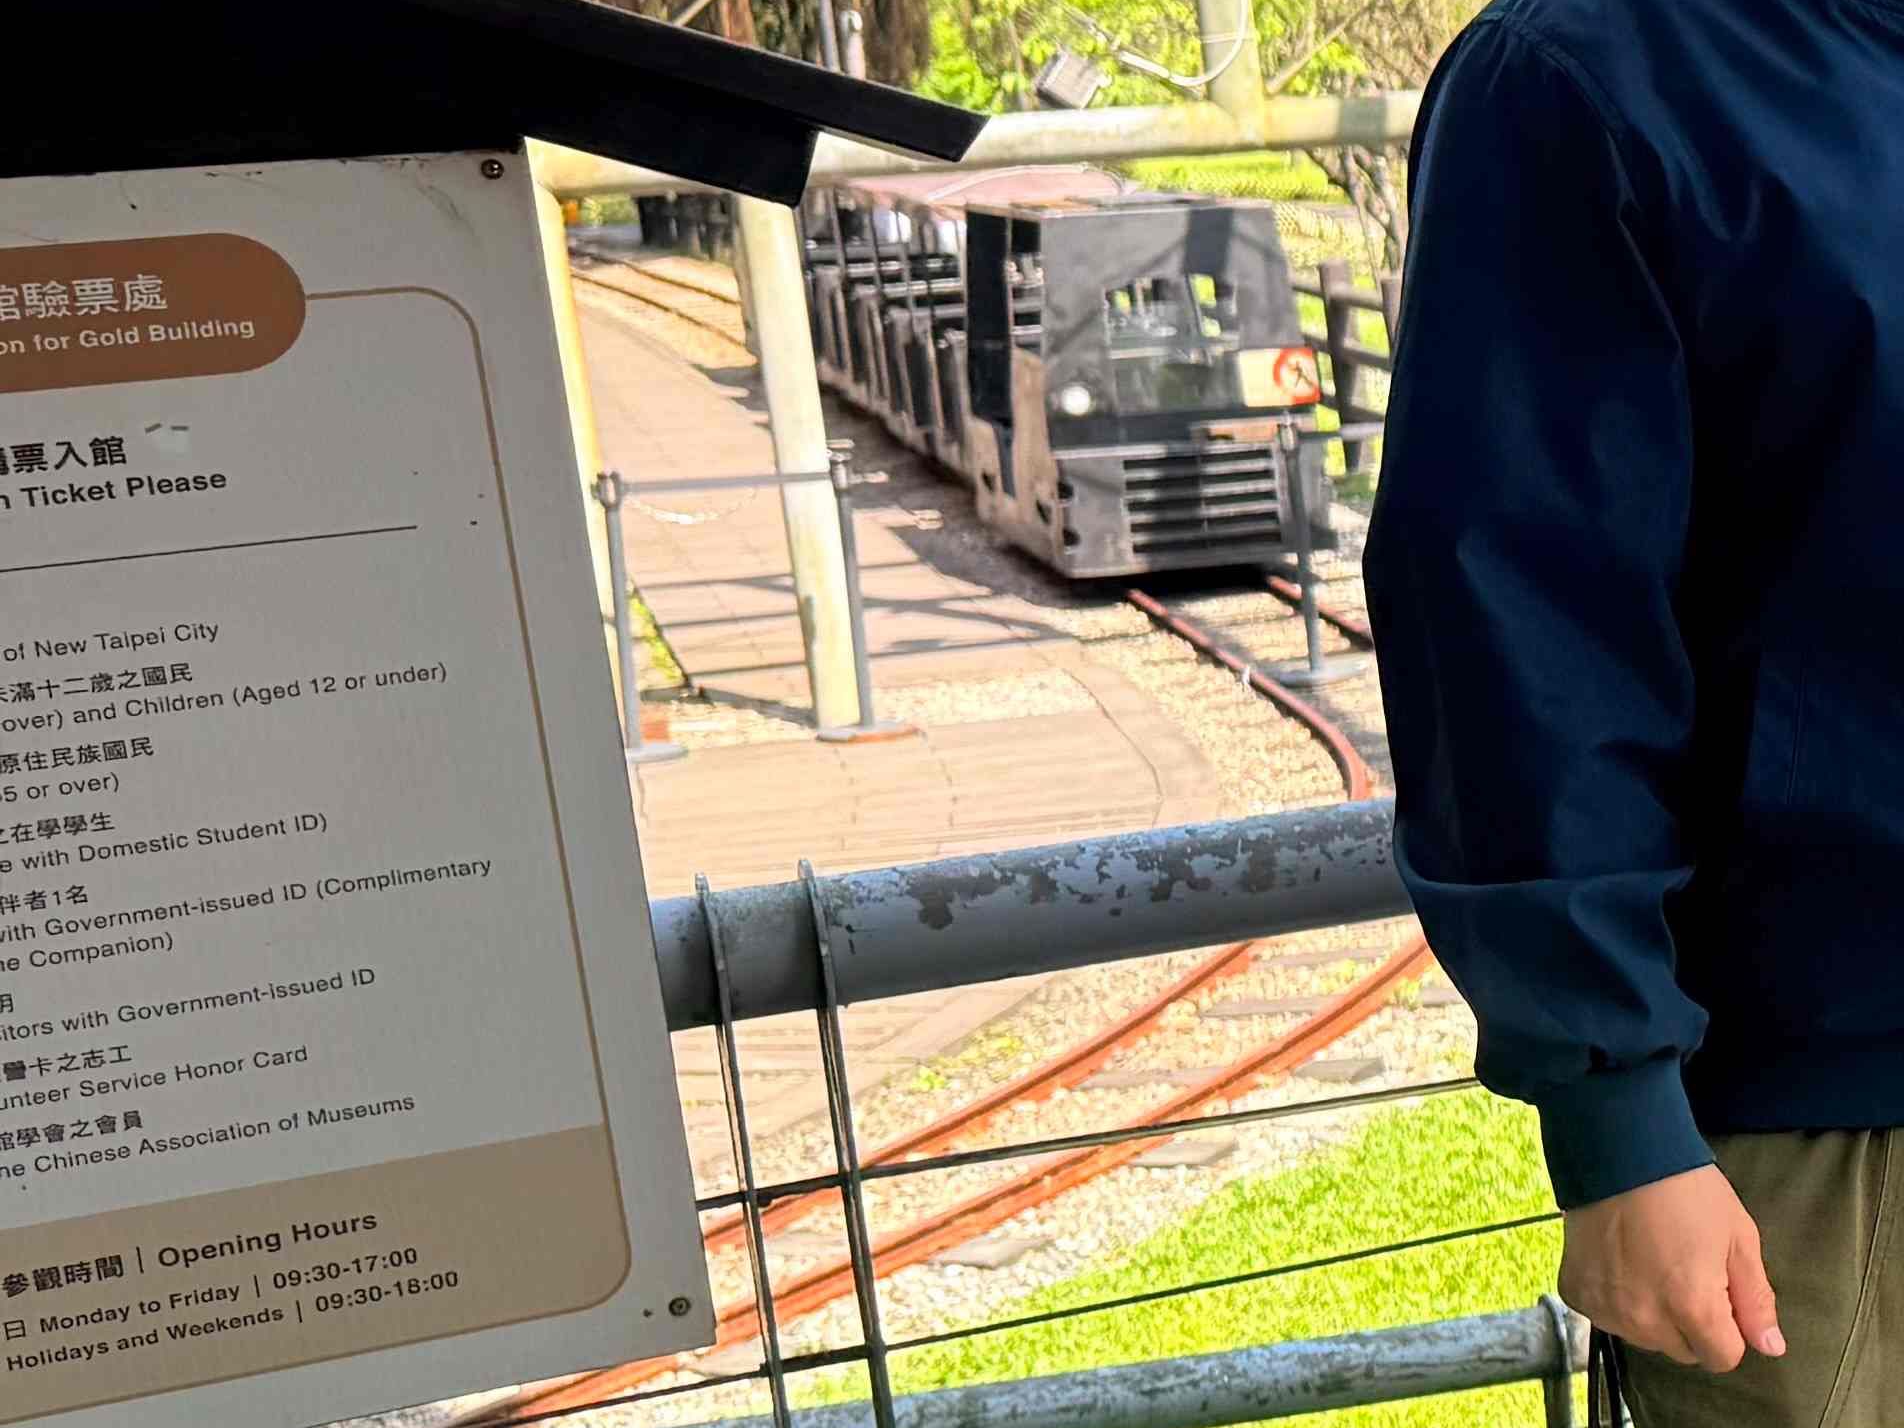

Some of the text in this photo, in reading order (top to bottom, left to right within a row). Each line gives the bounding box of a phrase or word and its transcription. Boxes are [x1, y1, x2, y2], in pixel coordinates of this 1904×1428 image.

[33, 333, 70, 351] for
[79, 327, 140, 348] Gold
[149, 320, 256, 343] Building
[0, 436, 127, 475] 票入館
[20, 480, 117, 508] Ticket
[125, 473, 227, 497] Please
[3, 622, 219, 662] of New Taipei City
[2, 662, 447, 732] over) and Children (Aged 12 or under)
[0, 772, 120, 803] 5 or over)
[22, 849, 70, 871] with
[78, 833, 189, 863] Domestic
[196, 819, 287, 846] Student
[294, 813, 328, 834] ID)
[45, 888, 274, 936] Government-issued
[283, 883, 307, 902] ID
[316, 860, 491, 900] (Complimentary
[29, 931, 174, 968] Companion)
[0, 968, 376, 1042] itors with Government-issued ID
[79, 1071, 167, 1097] Service
[174, 1058, 245, 1082] Honor
[253, 1045, 308, 1069] Card
[34, 1143, 131, 1174] Chinese
[138, 1120, 271, 1156] Association
[279, 1113, 299, 1131] of
[307, 1096, 415, 1127] Museums
[157, 1231, 282, 1269] Opening
[291, 1214, 378, 1244] Hours
[39, 1305, 130, 1334] Monday
[139, 1300, 161, 1316] to
[169, 1285, 240, 1310] Friday
[273, 1247, 418, 1290] 09:30-17:00
[6, 1271, 459, 1371] Holidays and Weekends 09:30-18:00
